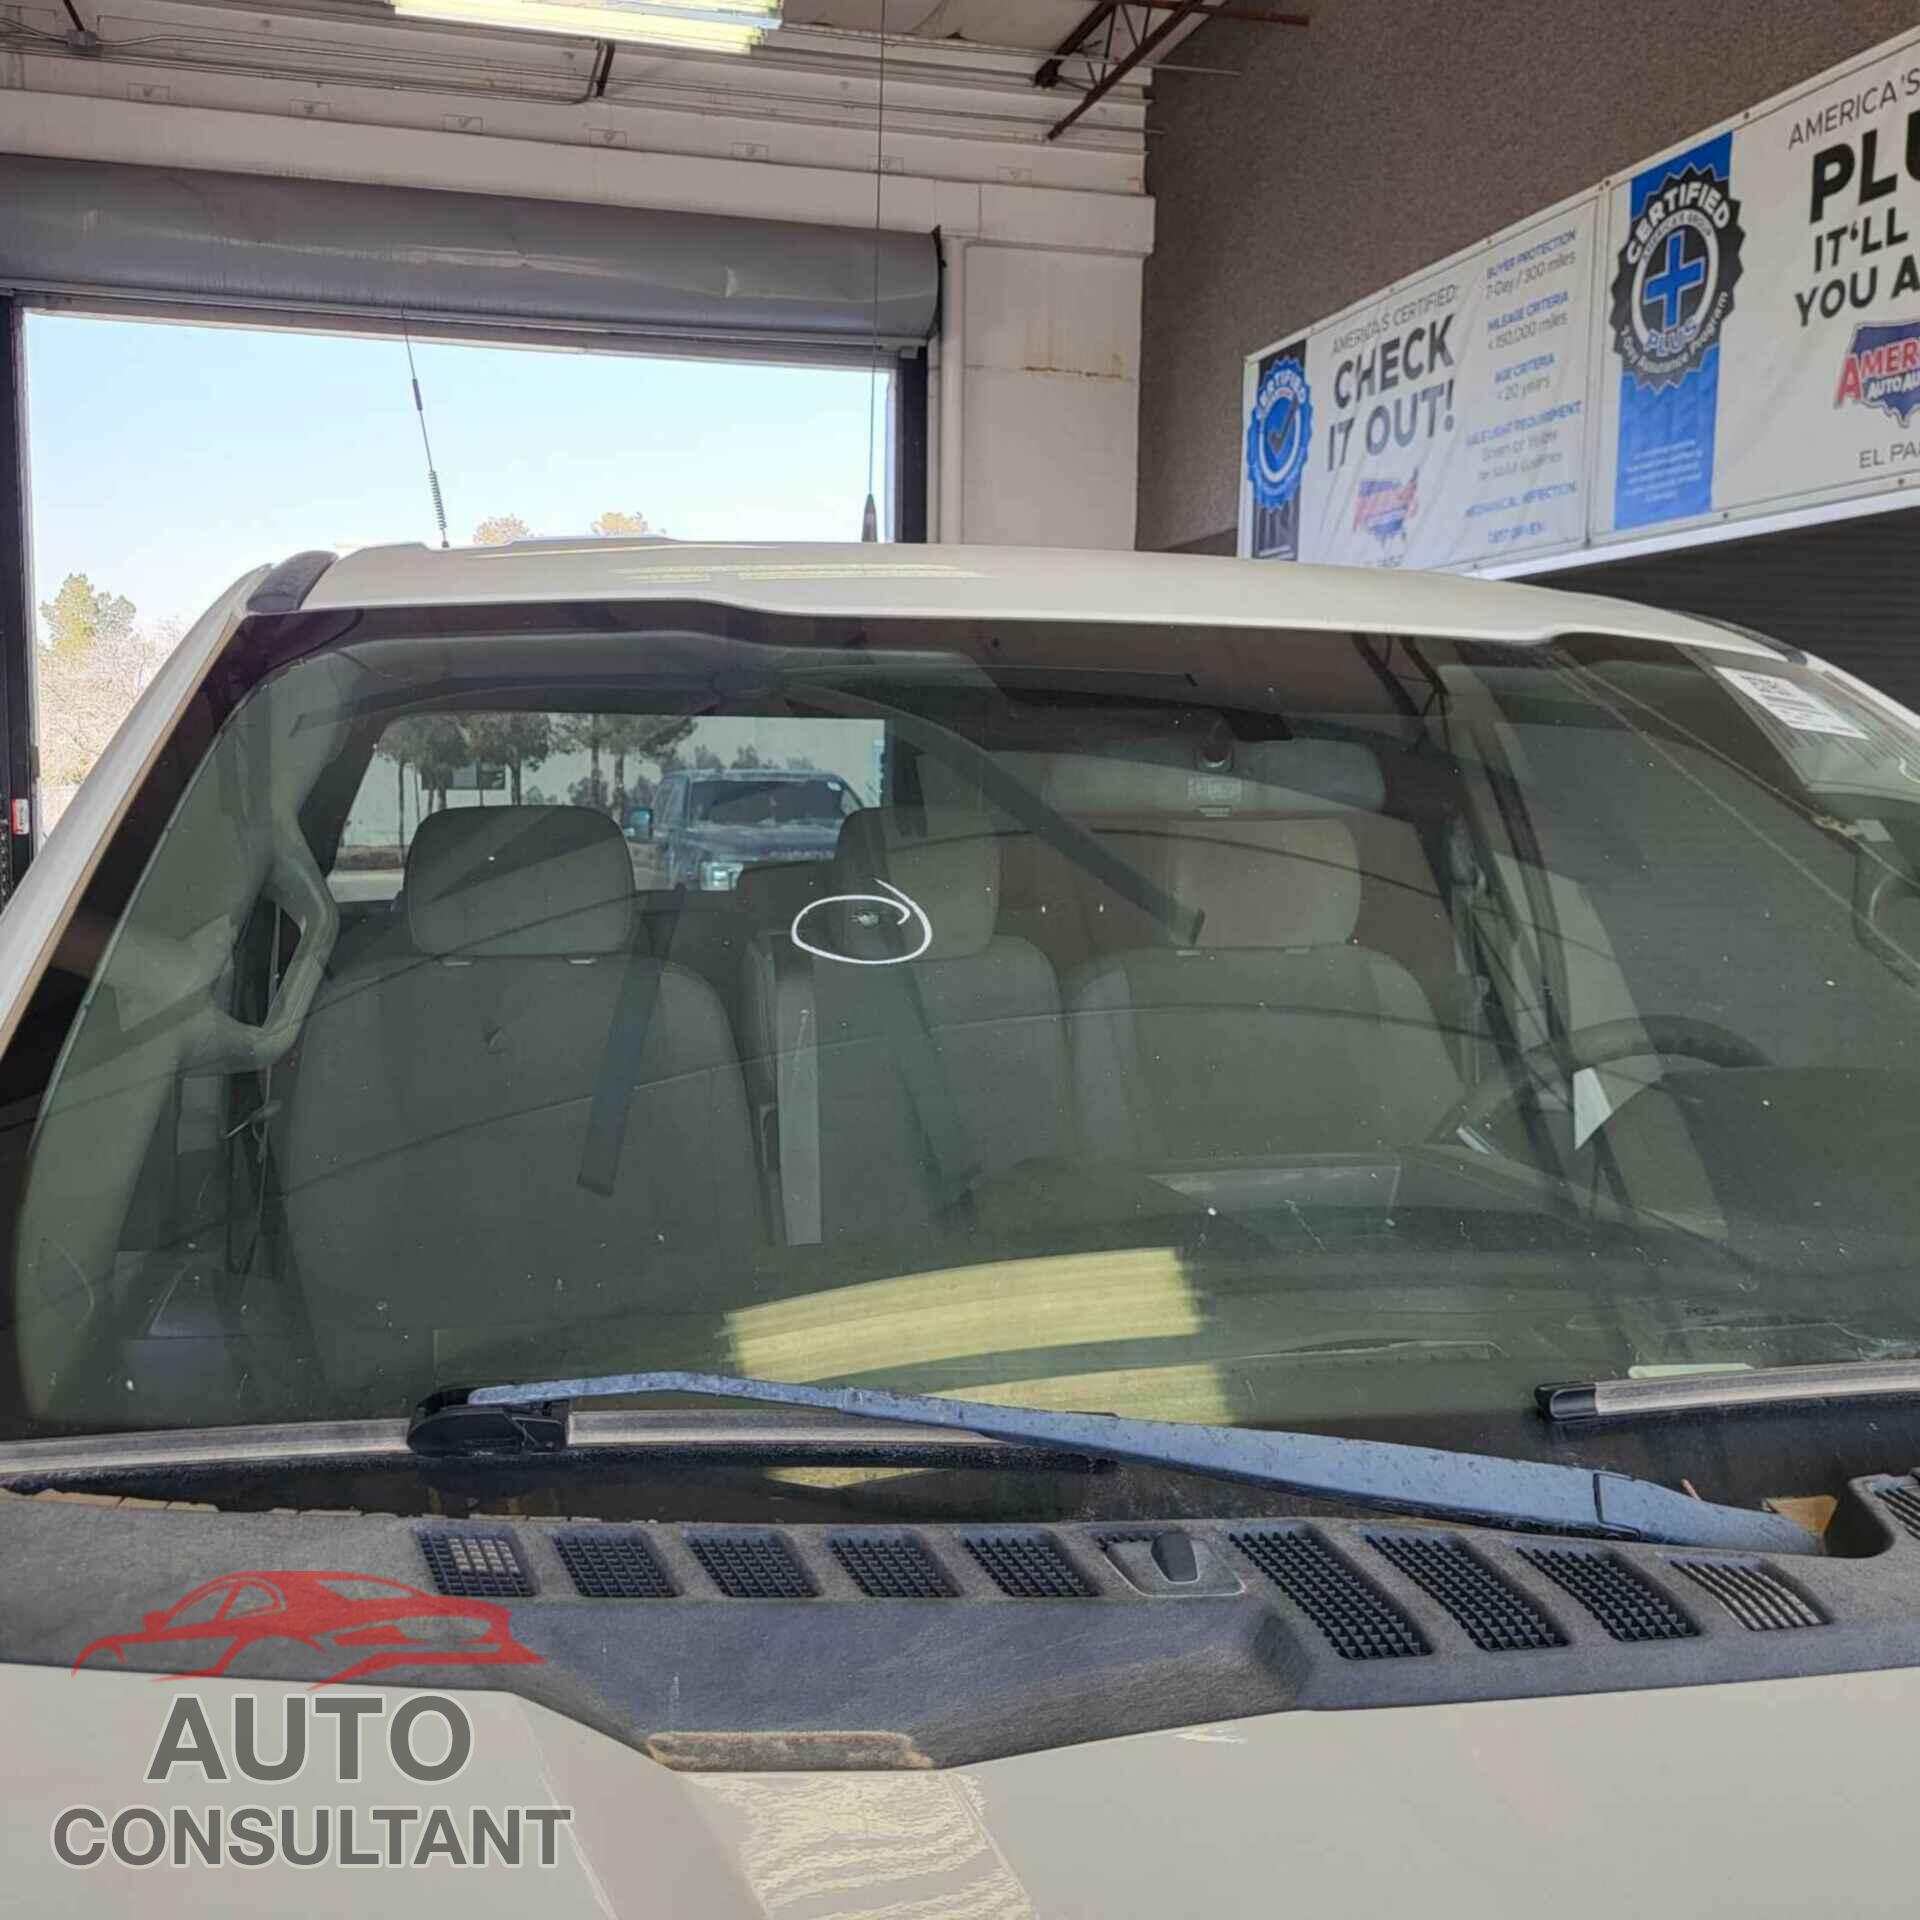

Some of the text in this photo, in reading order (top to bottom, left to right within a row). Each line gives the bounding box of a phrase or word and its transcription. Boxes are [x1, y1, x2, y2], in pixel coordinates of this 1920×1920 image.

[1788, 67, 1920, 151] AMERICA'S
[1626, 180, 1731, 265] CERTIFIED
[1794, 265, 1878, 328] YOU
[1333, 312, 1455, 410] CHECK
[1327, 417, 1355, 472] IT
[1366, 377, 1455, 457] OUT!
[1859, 441, 1920, 469] EL PA
